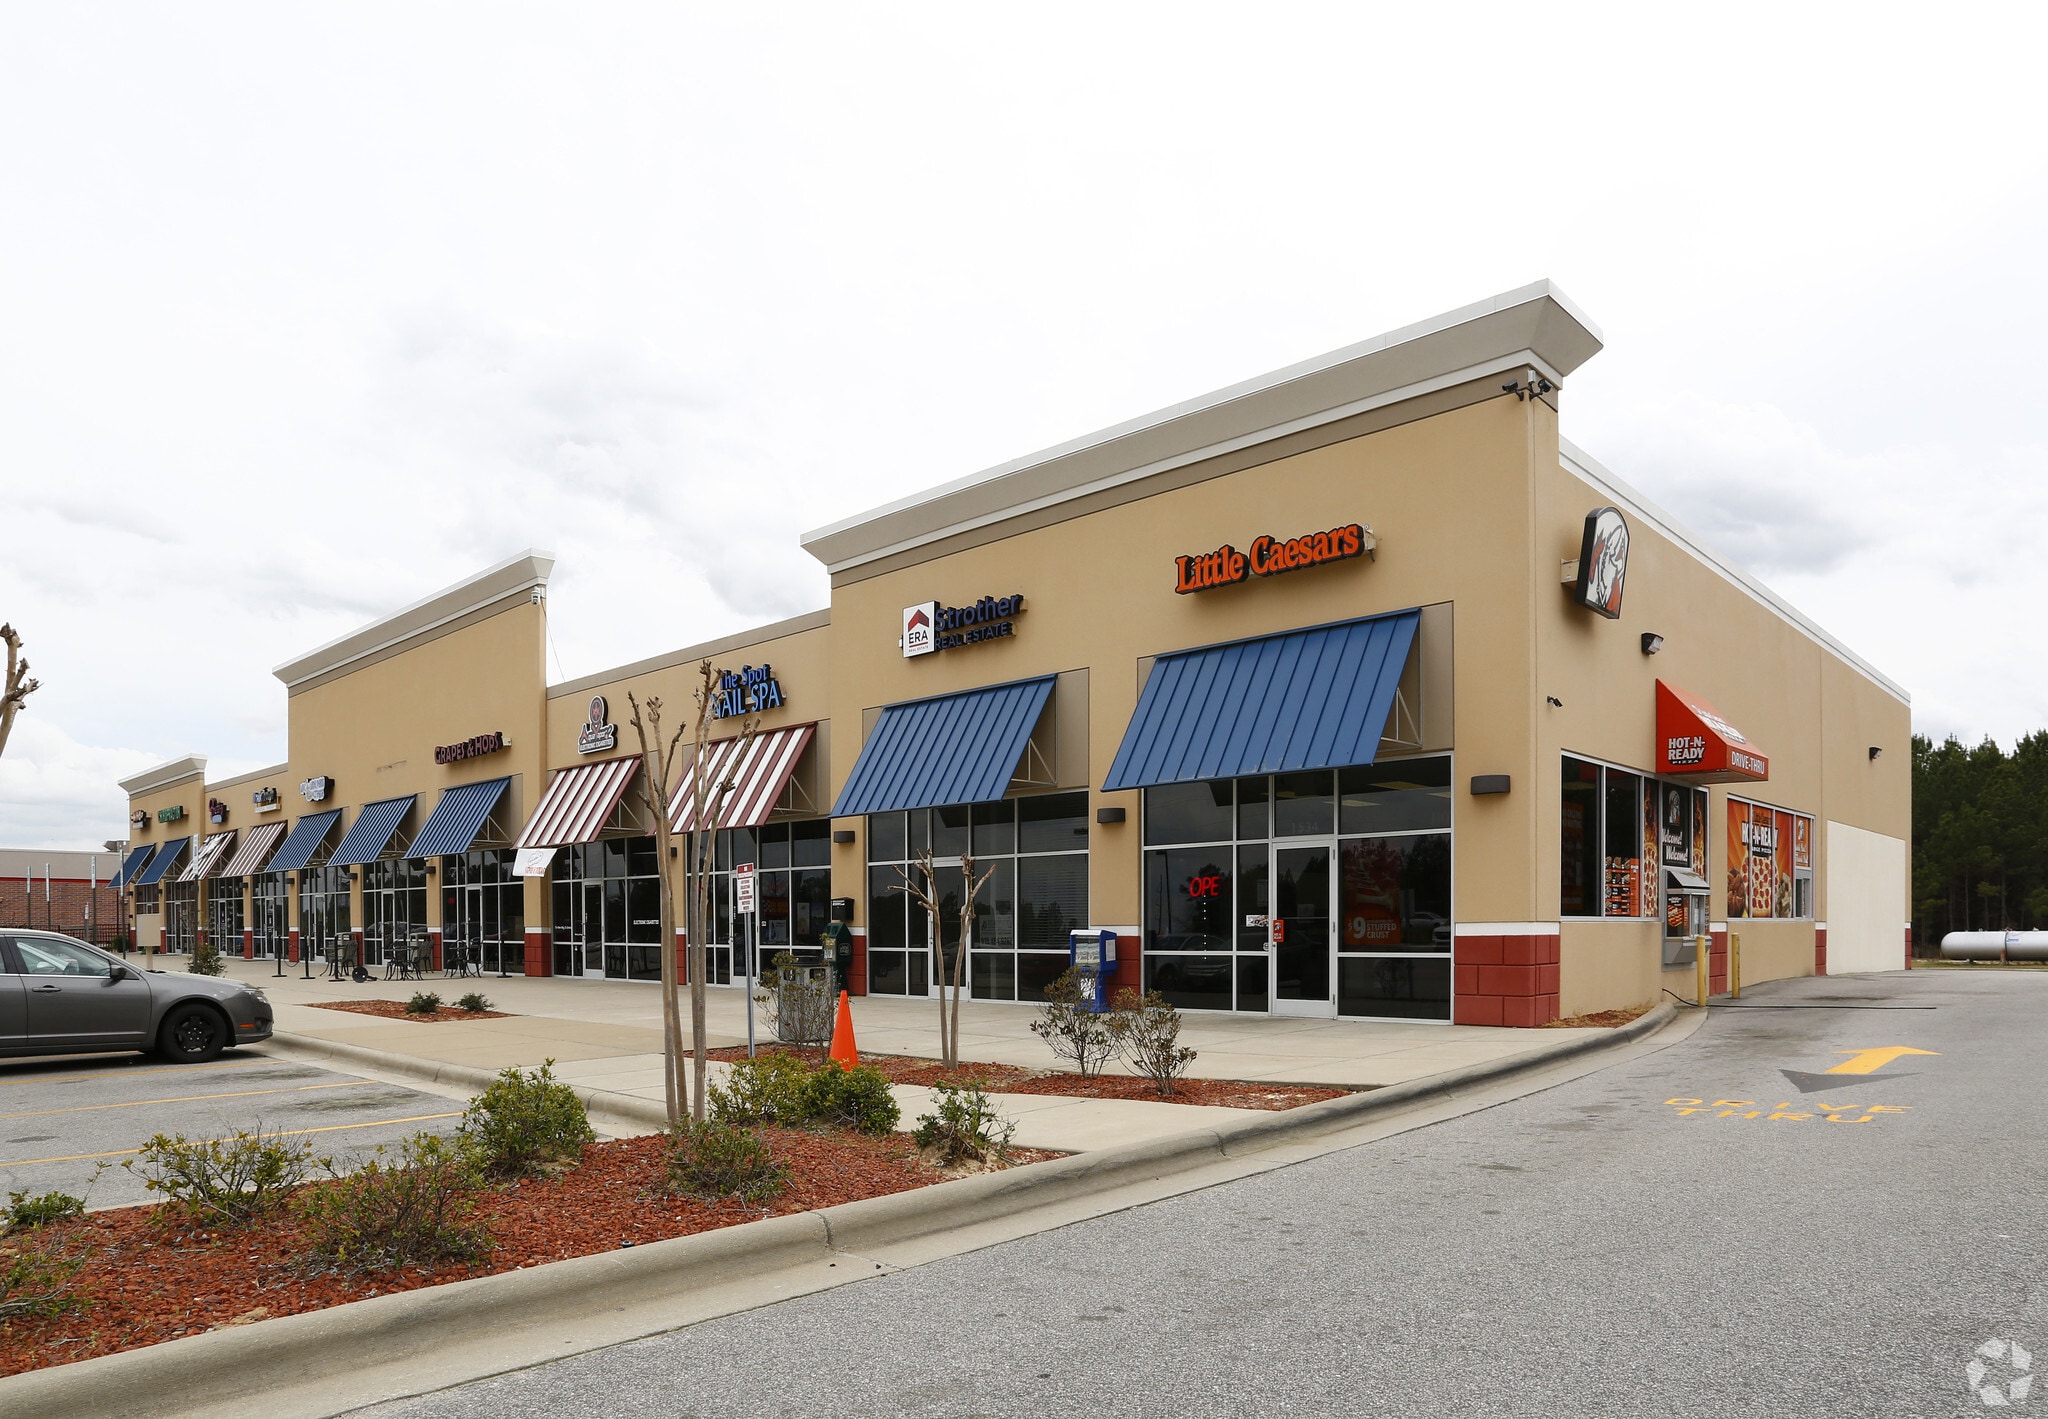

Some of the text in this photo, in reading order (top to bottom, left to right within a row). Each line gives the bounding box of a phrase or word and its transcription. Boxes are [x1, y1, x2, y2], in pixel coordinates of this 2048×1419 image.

[1175, 524, 1363, 595] Little Caesars
[935, 594, 1022, 632] Strother
[908, 630, 929, 644] ERA
[935, 622, 1011, 650] REAL ESTATE
[742, 664, 770, 690] Spot
[751, 680, 780, 712] SPA
[435, 732, 502, 764] GRAPES & HOPS
[1668, 736, 1706, 749] HOT-N-
[1668, 748, 1705, 760] READY
[1291, 822, 1318, 833] 1534
[1366, 922, 1397, 931] STUFFED
[1366, 931, 1391, 939] CRUST
[1663, 1098, 1913, 1114] DRIVE
[1674, 1107, 1873, 1123] THRU
